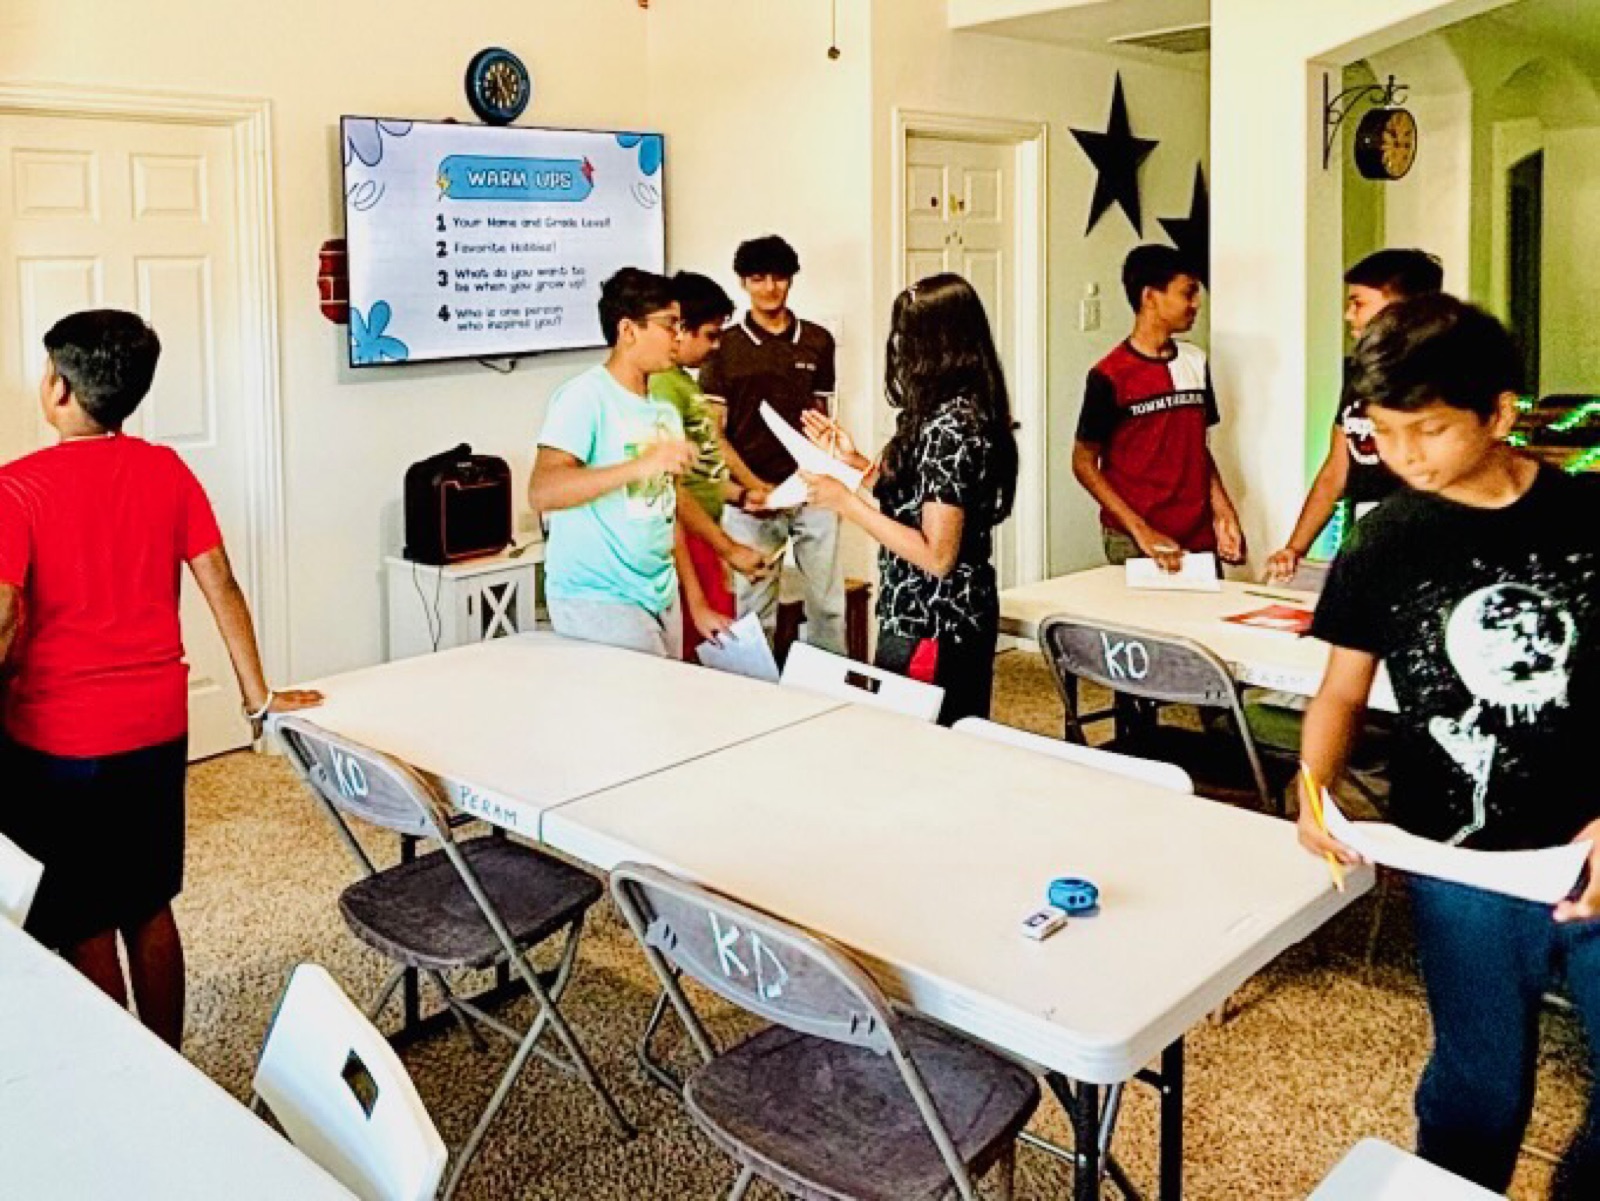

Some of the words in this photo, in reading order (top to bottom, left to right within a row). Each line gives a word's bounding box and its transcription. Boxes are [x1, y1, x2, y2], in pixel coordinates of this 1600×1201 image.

[468, 169, 527, 188] WARM
[536, 170, 572, 190] UPS
[436, 213, 446, 232] 1
[453, 217, 482, 228] Your
[487, 218, 517, 228] Name
[521, 218, 541, 228] and
[545, 218, 578, 228] Grade
[436, 240, 448, 258] 2
[455, 242, 506, 253] Favorite
[438, 269, 448, 287] 3
[455, 268, 489, 279] What
[493, 268, 508, 278] do
[510, 269, 533, 280] you
[537, 267, 568, 277] want
[572, 266, 586, 276] to
[455, 281, 470, 292] be
[475, 280, 507, 291] when
[510, 282, 532, 294] you
[535, 280, 566, 292] grow
[438, 304, 451, 322] 4
[455, 308, 482, 319] Who
[486, 308, 496, 317] is
[499, 307, 520, 316] one
[525, 305, 564, 317] person
[457, 320, 484, 331] who
[458, 785, 518, 826] PERAM
[708, 911, 788, 1000] KD
